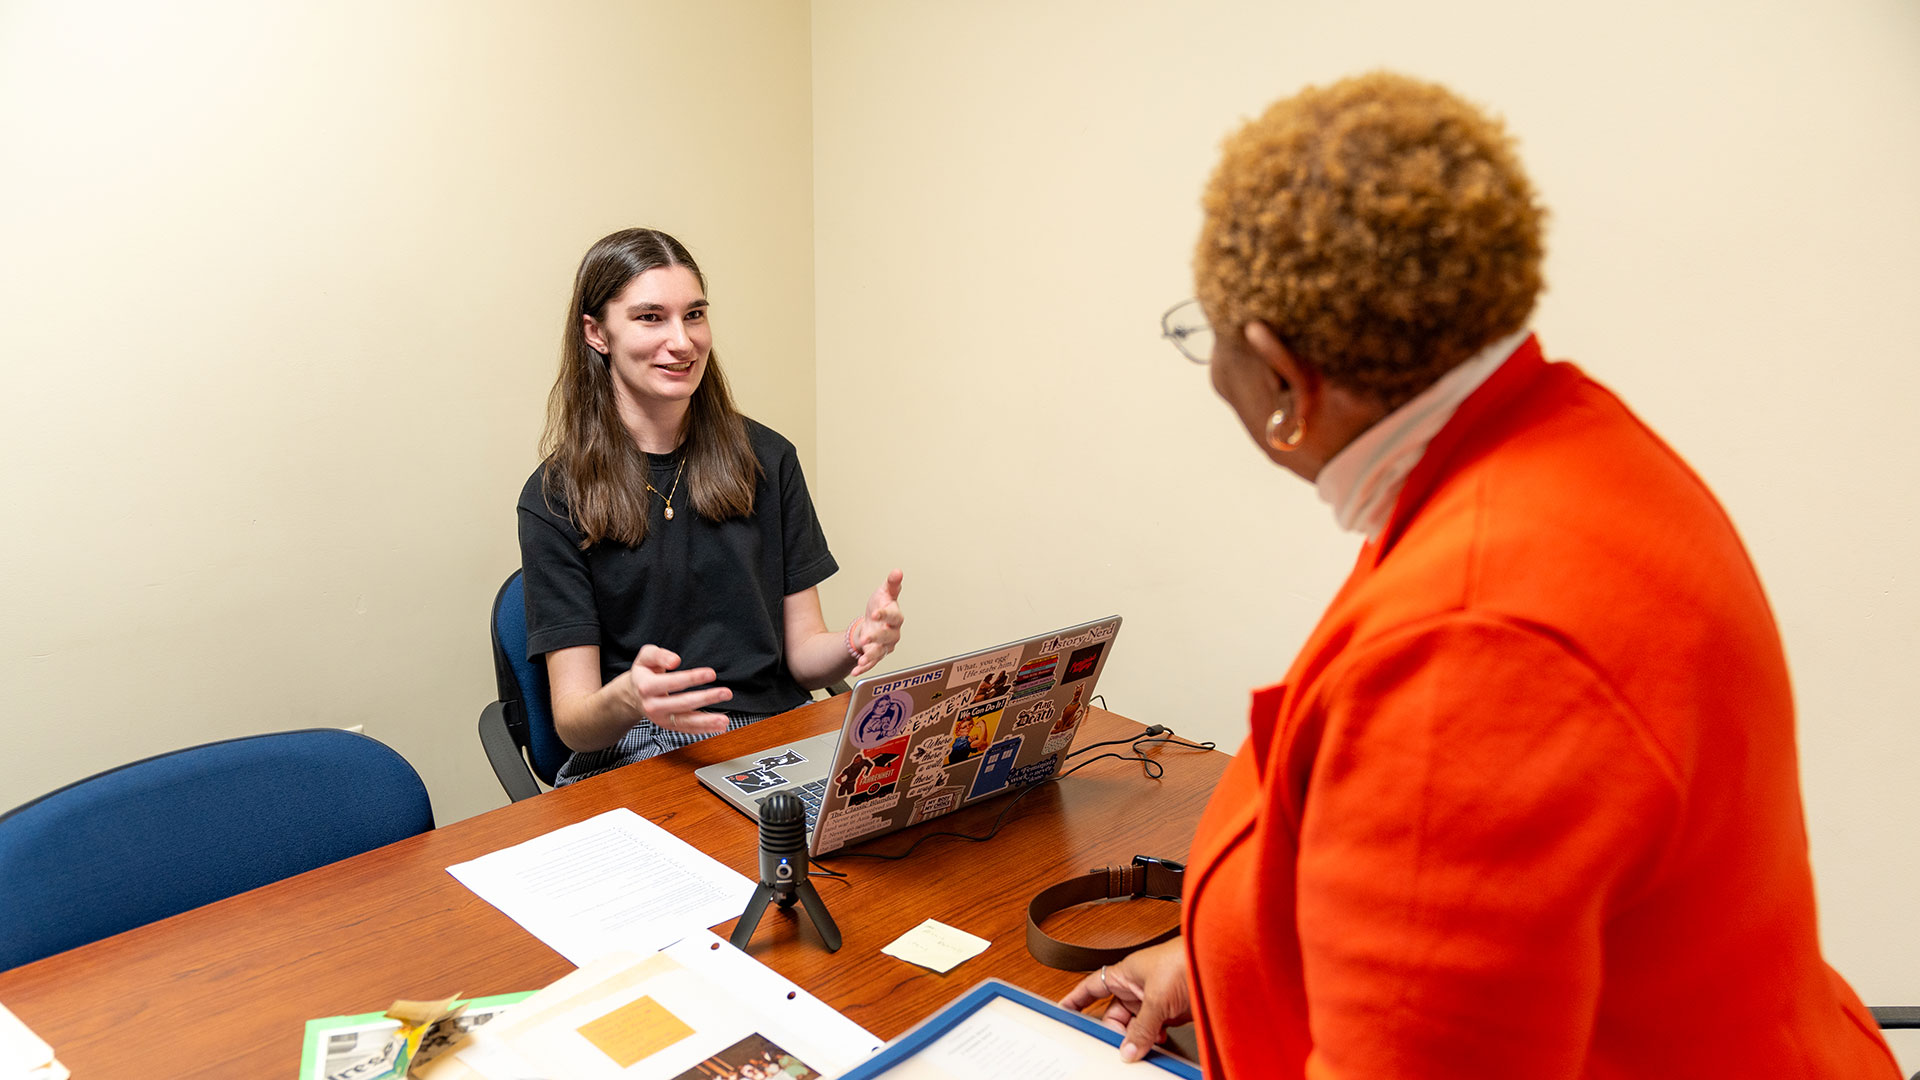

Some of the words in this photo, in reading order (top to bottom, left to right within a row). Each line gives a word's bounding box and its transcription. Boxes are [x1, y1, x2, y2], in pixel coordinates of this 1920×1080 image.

[1041, 636, 1085, 653] History
[1087, 623, 1115, 639] Nerd
[980, 658, 993, 666] you
[994, 653, 1009, 664] egg!
[980, 664, 997, 673] stabs
[874, 670, 942, 695] CAPTAINS
[960, 711, 971, 719] We
[972, 706, 985, 716] Can
[985, 703, 995, 712] Do
[996, 699, 1004, 709] It!
[1016, 708, 1054, 727] Death
[923, 736, 952, 750] Where
[830, 810, 843, 819] The
[844, 802, 868, 814] Classic
[869, 792, 899, 807] Blunders
[832, 814, 849, 824] Never
